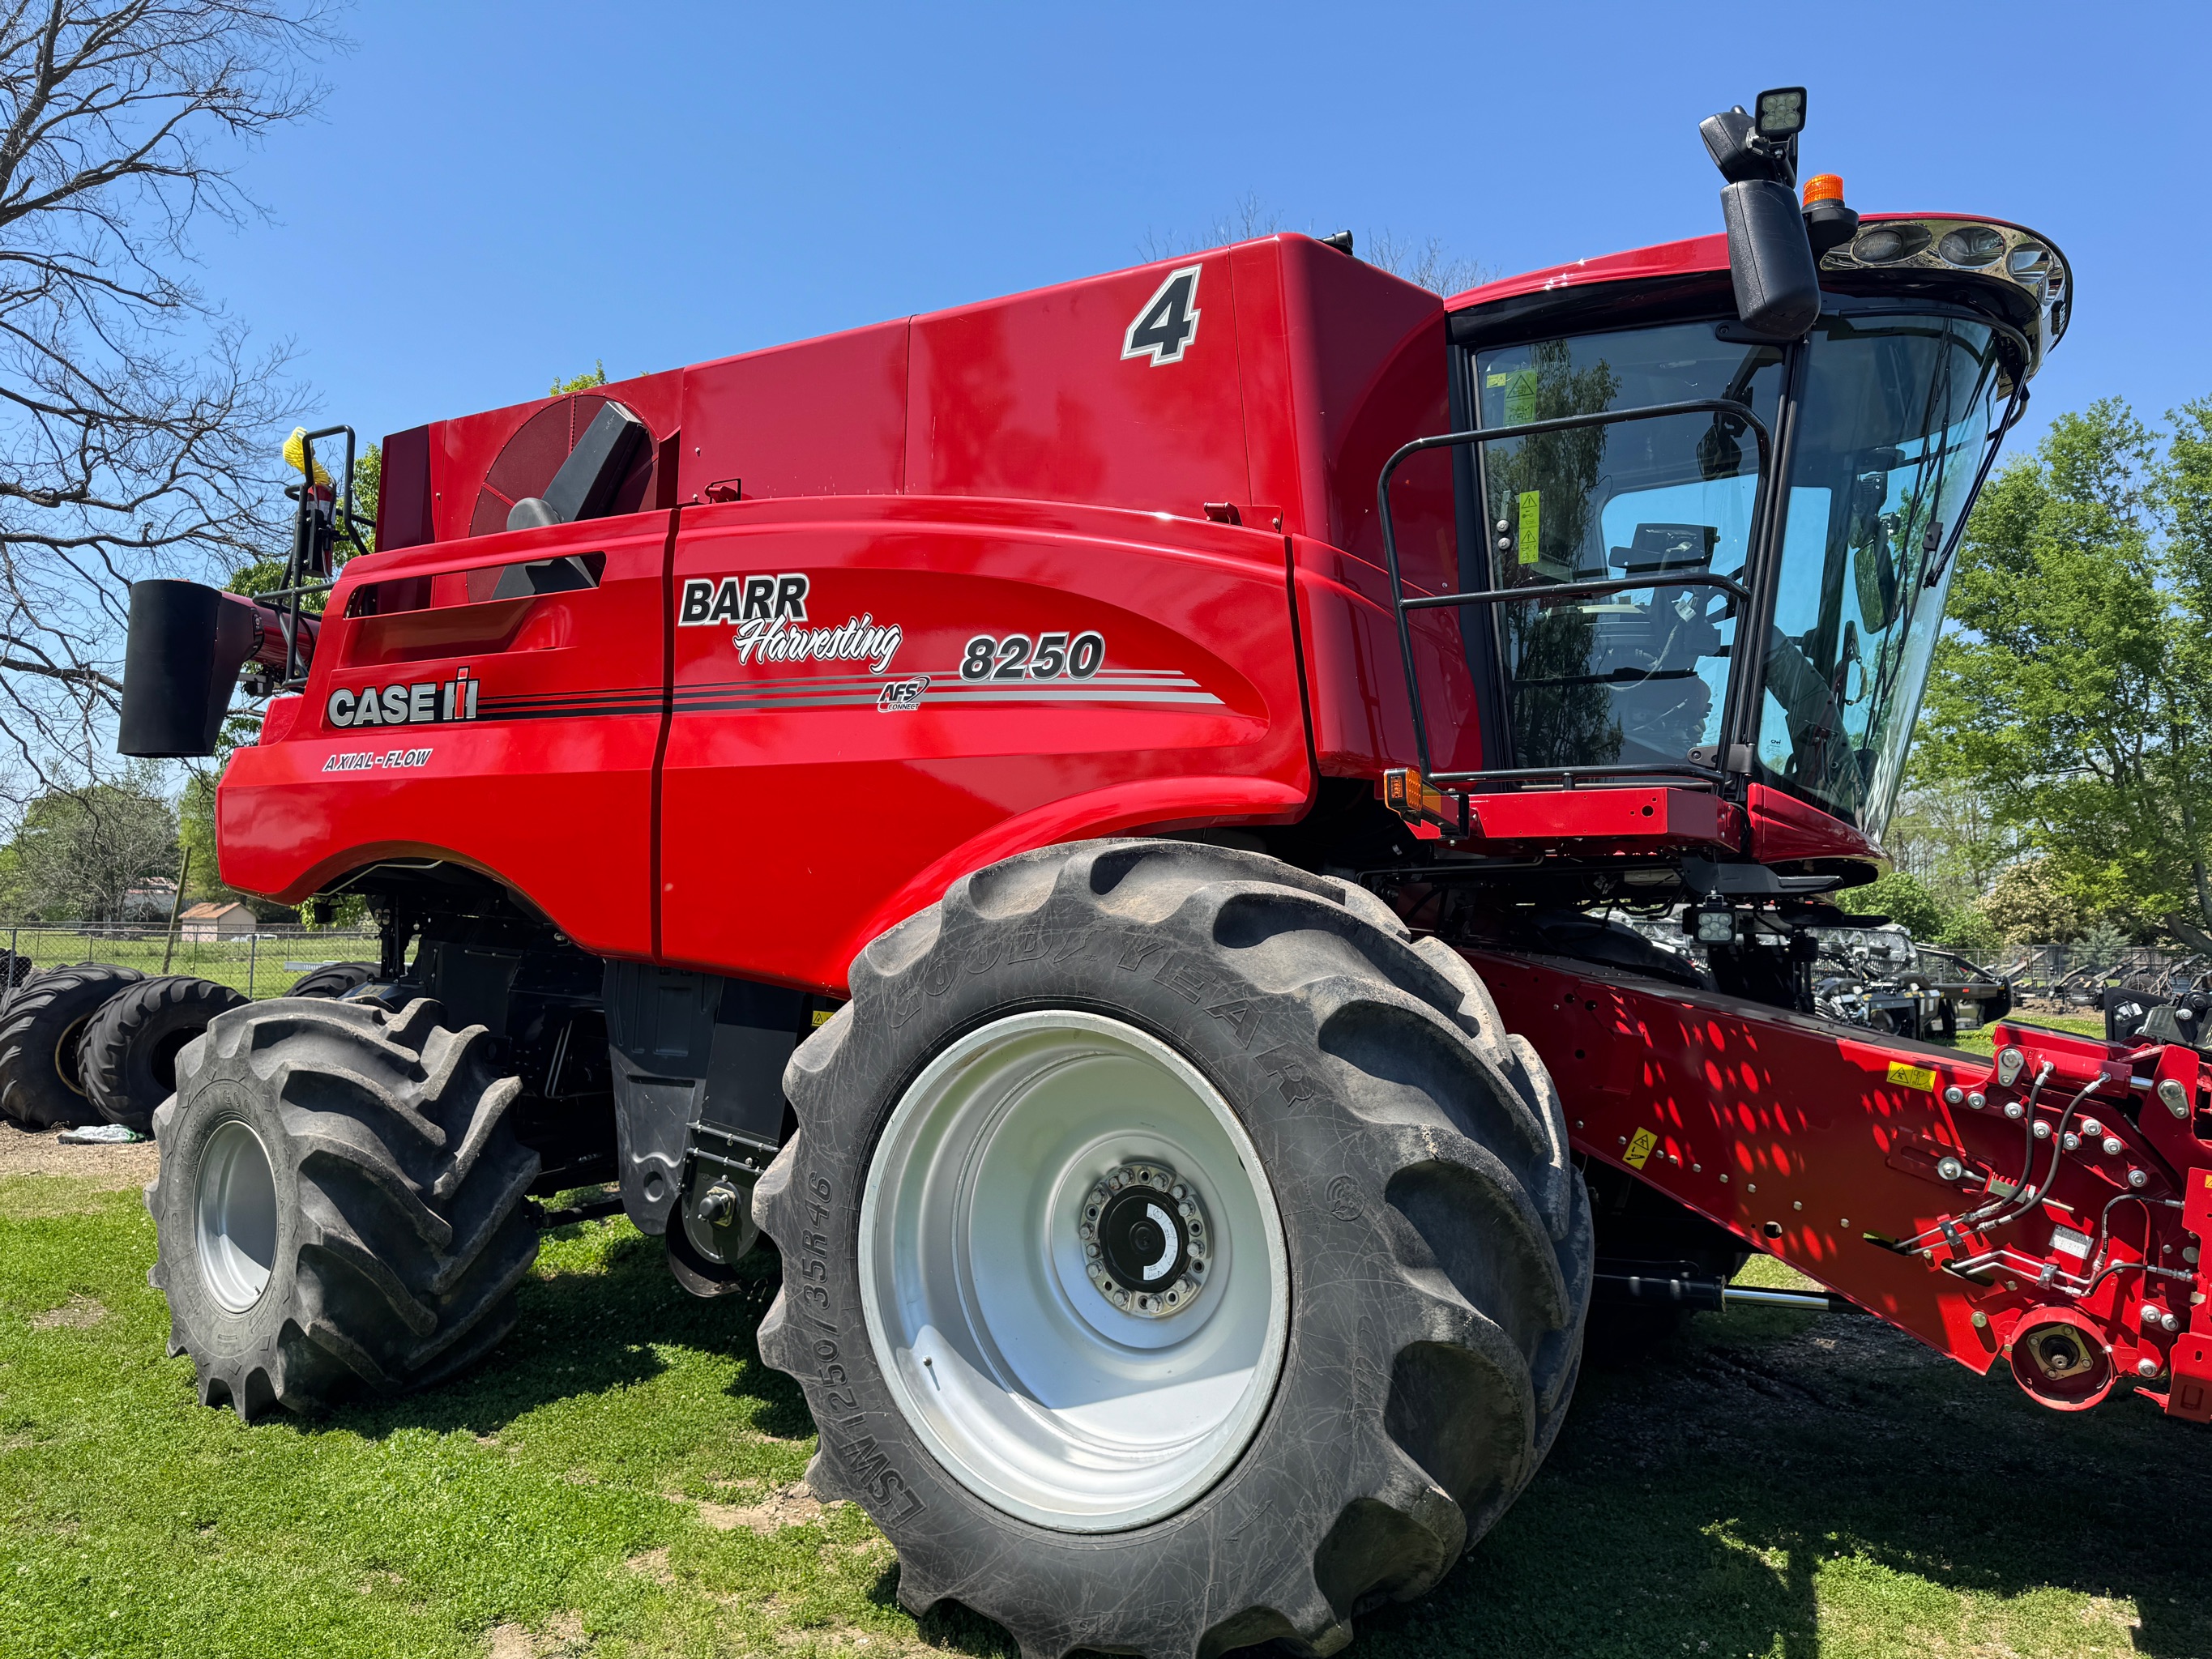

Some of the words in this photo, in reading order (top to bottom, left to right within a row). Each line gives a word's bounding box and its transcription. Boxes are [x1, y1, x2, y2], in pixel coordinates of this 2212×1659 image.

[1120, 263, 1202, 368] 4
[677, 573, 810, 627] BARR
[733, 612, 902, 675] Harvesting
[959, 630, 1105, 682] 8250
[328, 683, 437, 727] CASE
[877, 680, 921, 703] AFS
[888, 702, 920, 711] CONNECT
[322, 748, 434, 772] AXIAL-FLOW
